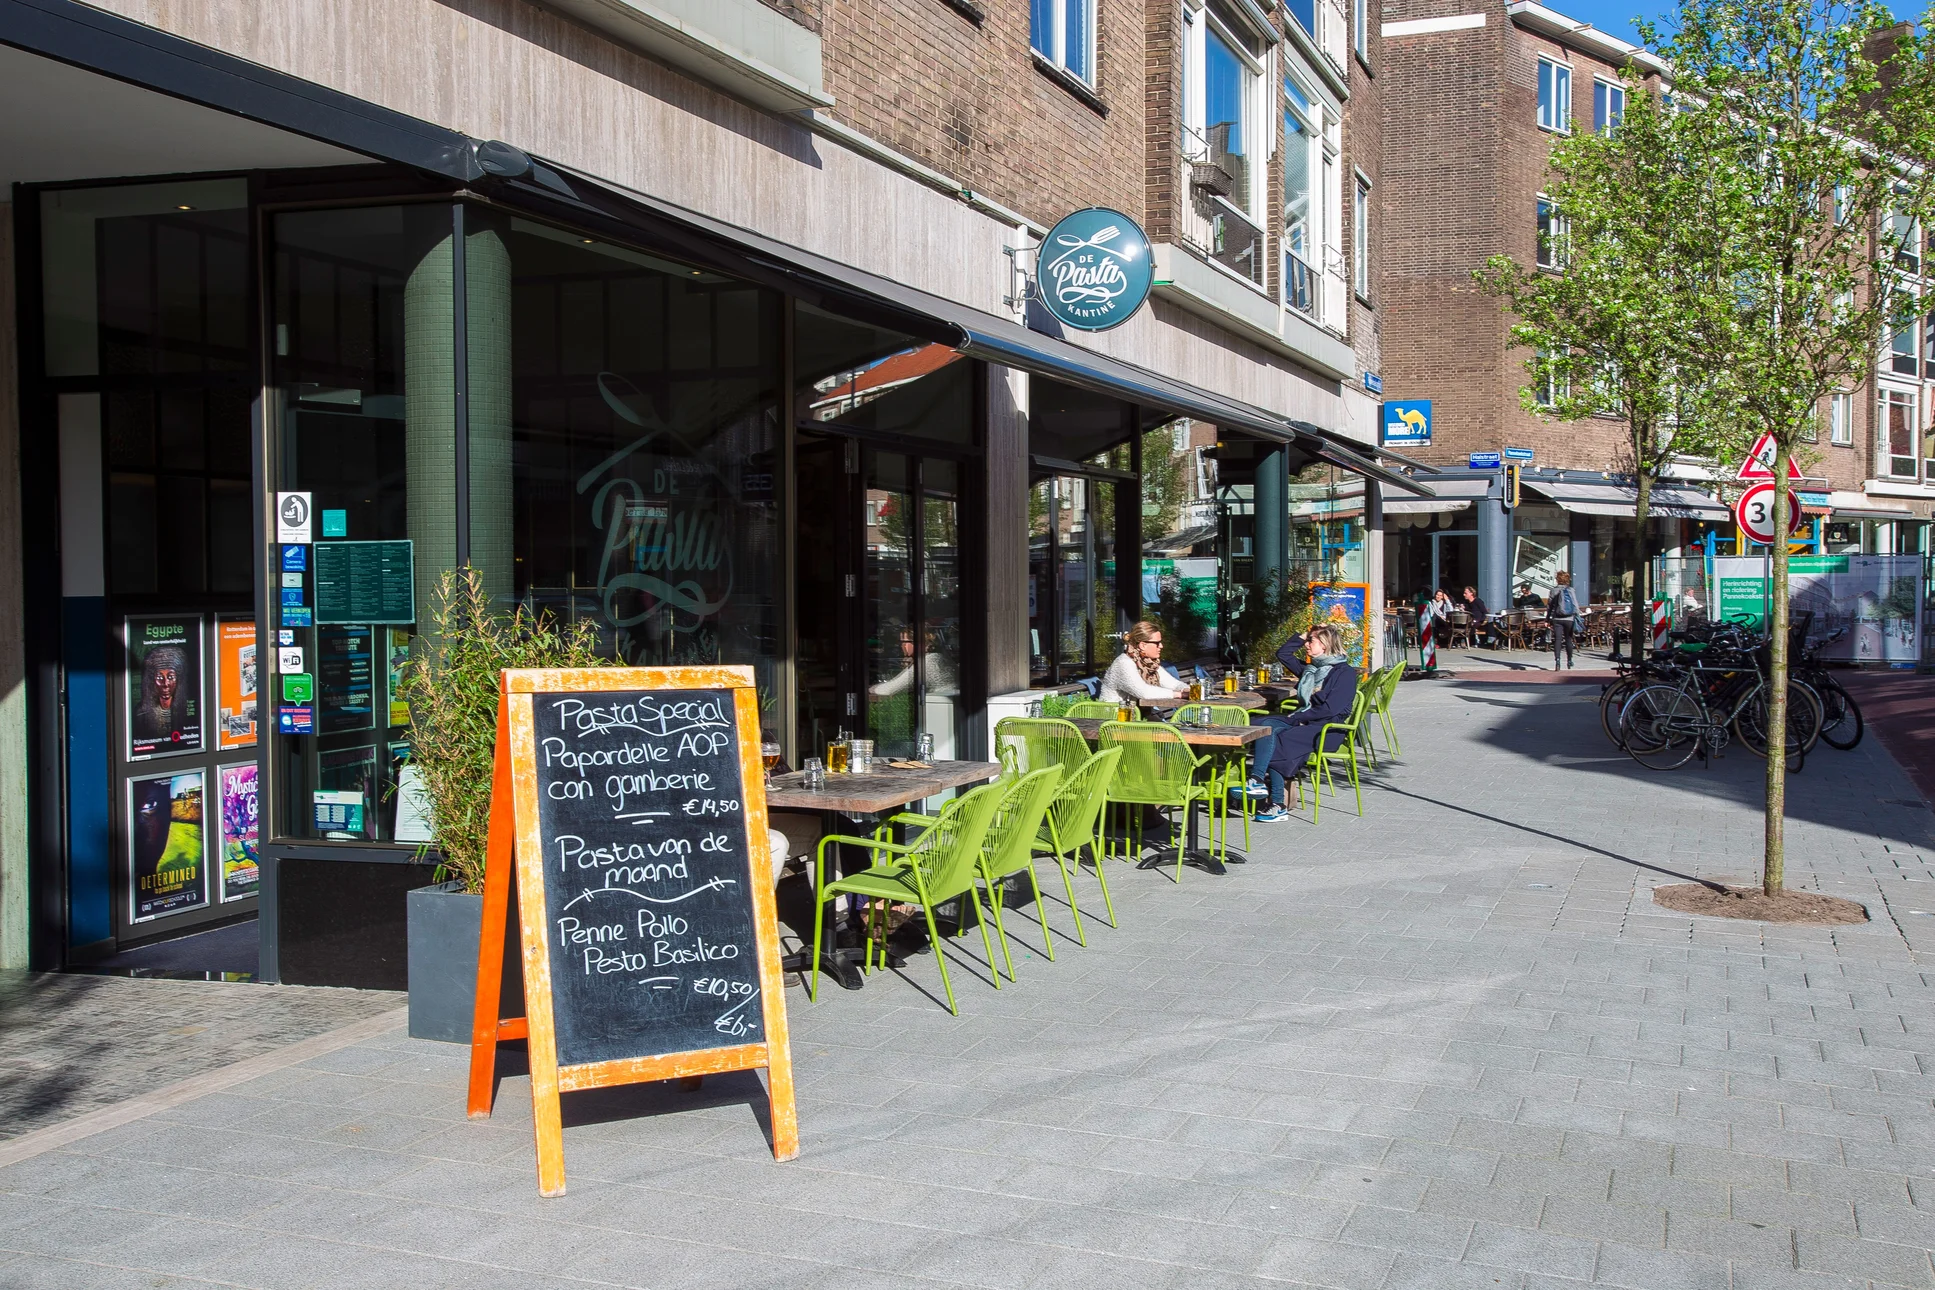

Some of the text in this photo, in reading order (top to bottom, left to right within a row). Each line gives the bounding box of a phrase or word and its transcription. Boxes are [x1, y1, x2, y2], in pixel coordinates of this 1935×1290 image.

[1080, 255, 1093, 263] DE
[1053, 256, 1127, 298] Pasta
[1068, 301, 1115, 317] KANTINE
[653, 468, 680, 495] DE
[592, 478, 732, 598] Pasta
[1722, 580, 1763, 588] Herinrichting
[145, 623, 184, 638] Egypte
[552, 696, 730, 733] Pasta Special
[133, 738, 163, 746] Rijksmuseum
[541, 731, 730, 776] Papardelle AOP
[225, 775, 258, 801] Mystic
[548, 769, 716, 811] con gamberie
[681, 798, 740, 818] €14,50
[554, 831, 734, 872] Pasta van de
[142, 867, 196, 890] DETERMINED
[604, 855, 688, 889] maand
[556, 908, 689, 946] Penne Pollo
[583, 939, 739, 975] Pesto Basilico
[693, 977, 753, 1001] €10,50
